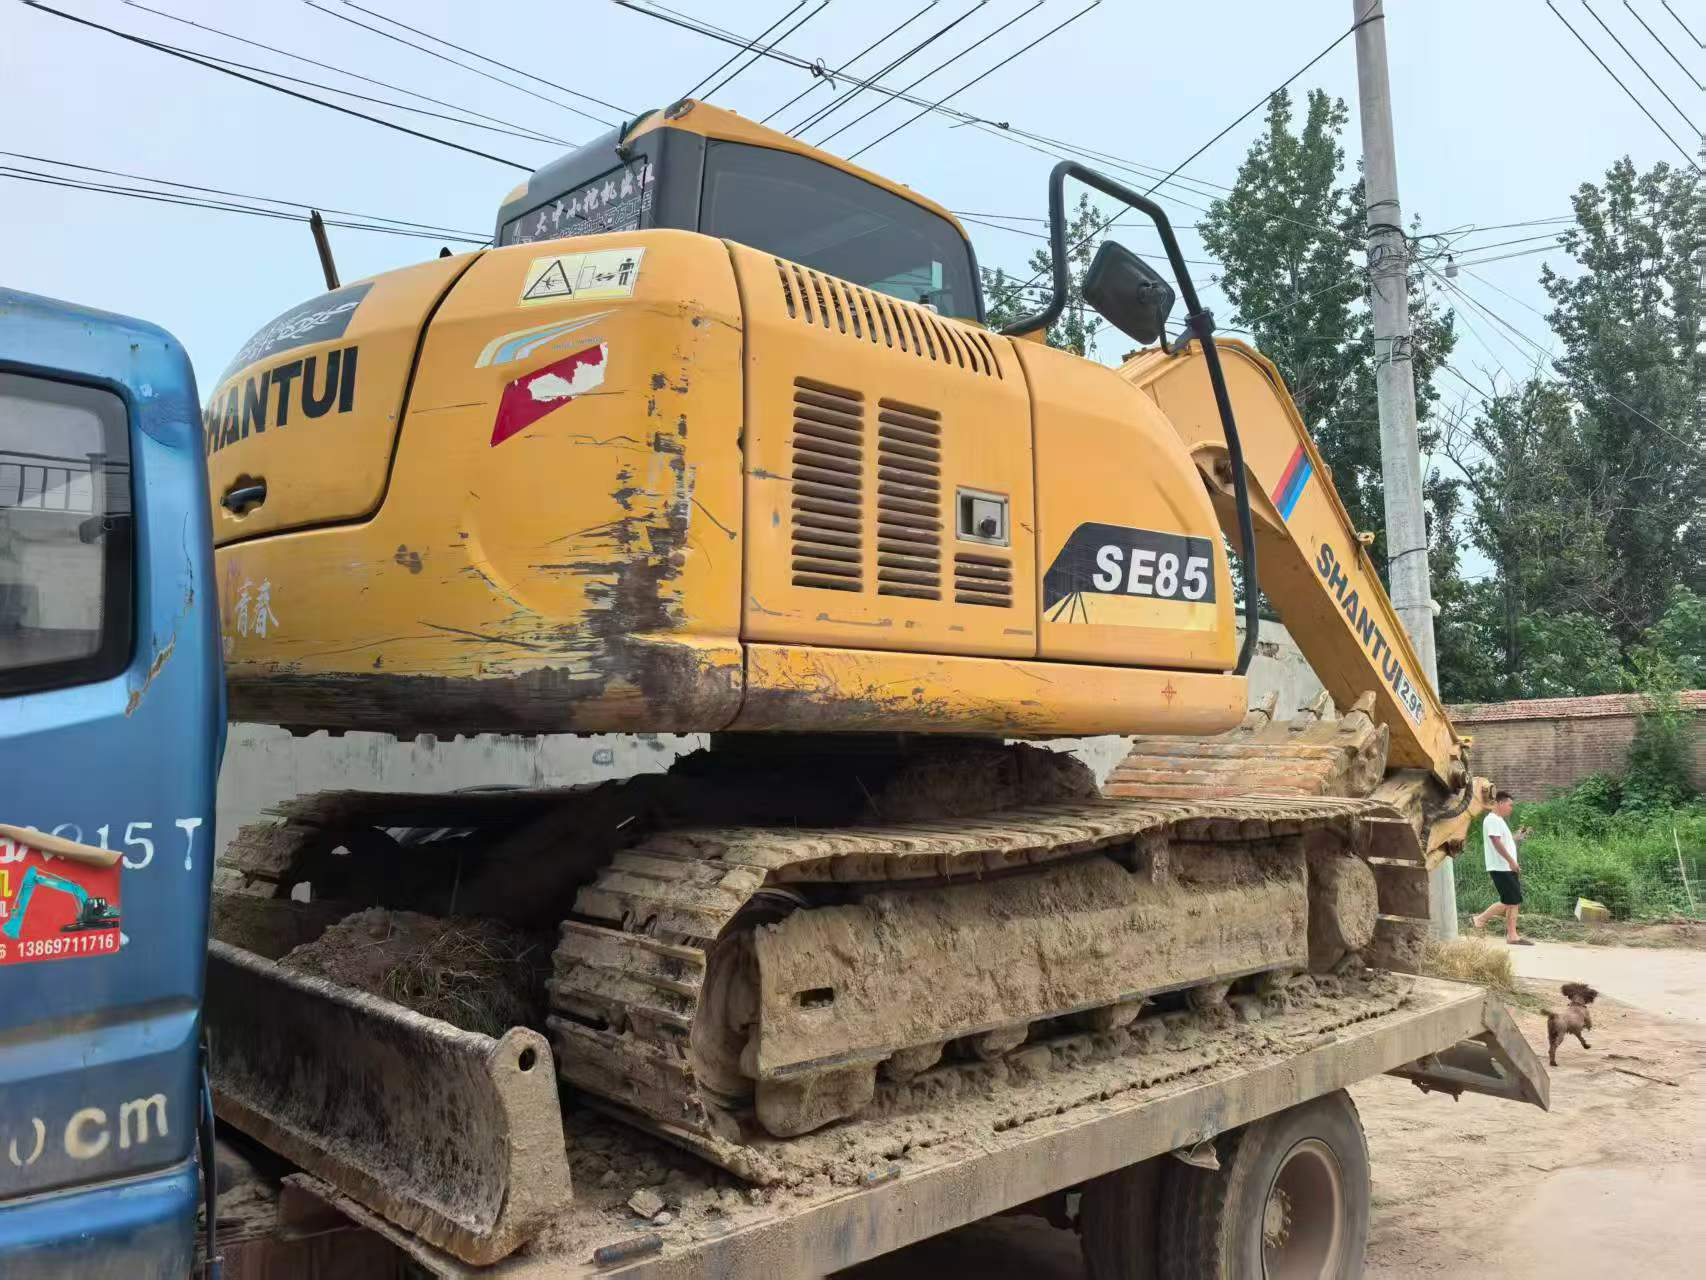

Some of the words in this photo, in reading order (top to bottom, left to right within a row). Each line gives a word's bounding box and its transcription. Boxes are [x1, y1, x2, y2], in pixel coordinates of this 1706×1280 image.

[1091, 544, 1209, 601] SE85
[1316, 542, 1404, 694] SHANTUI
[18, 933, 114, 958] 13869711716
